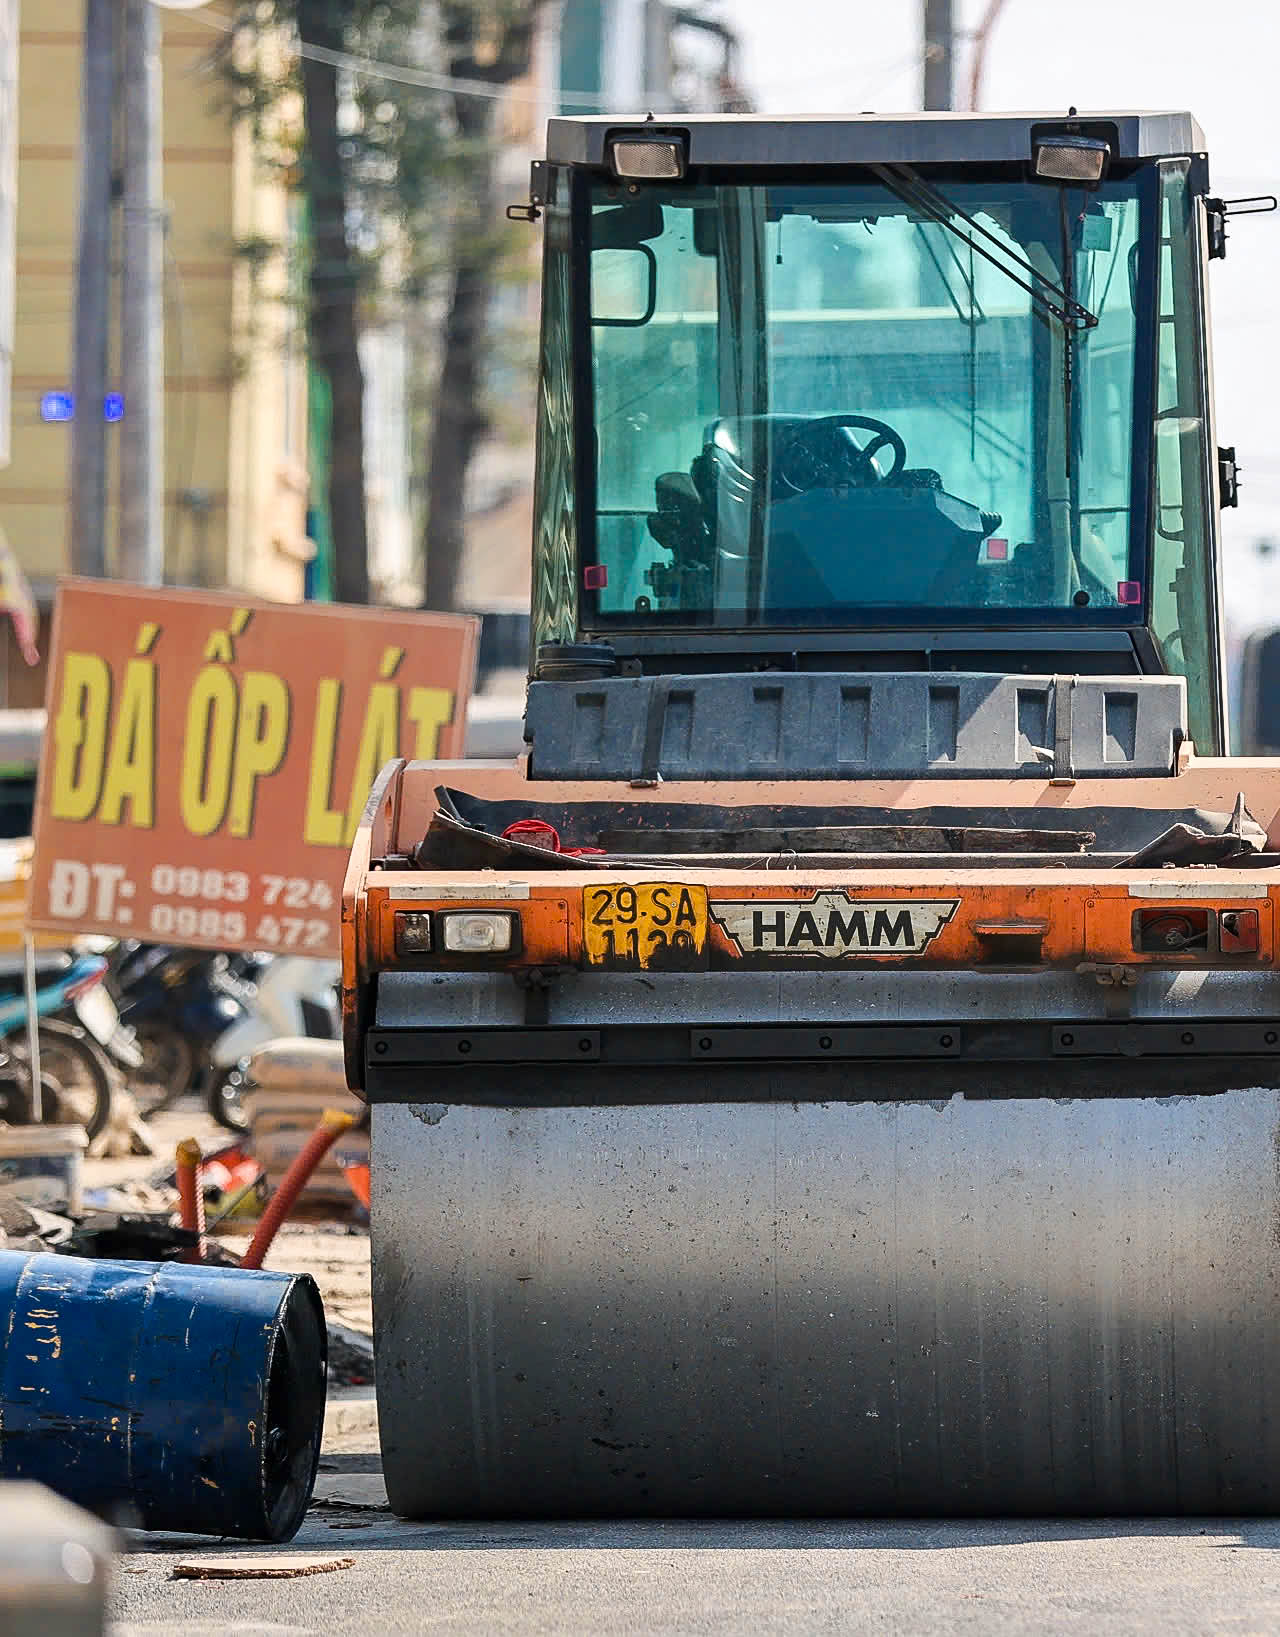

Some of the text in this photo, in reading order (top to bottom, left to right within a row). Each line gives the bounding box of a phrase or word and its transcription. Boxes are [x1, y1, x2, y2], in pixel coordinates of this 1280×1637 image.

[51, 621, 160, 829] ĐÁ
[180, 607, 291, 839] ỐP
[49, 859, 137, 923] ĐT:
[261, 874, 333, 910] 724
[752, 909, 917, 947] HAMM
